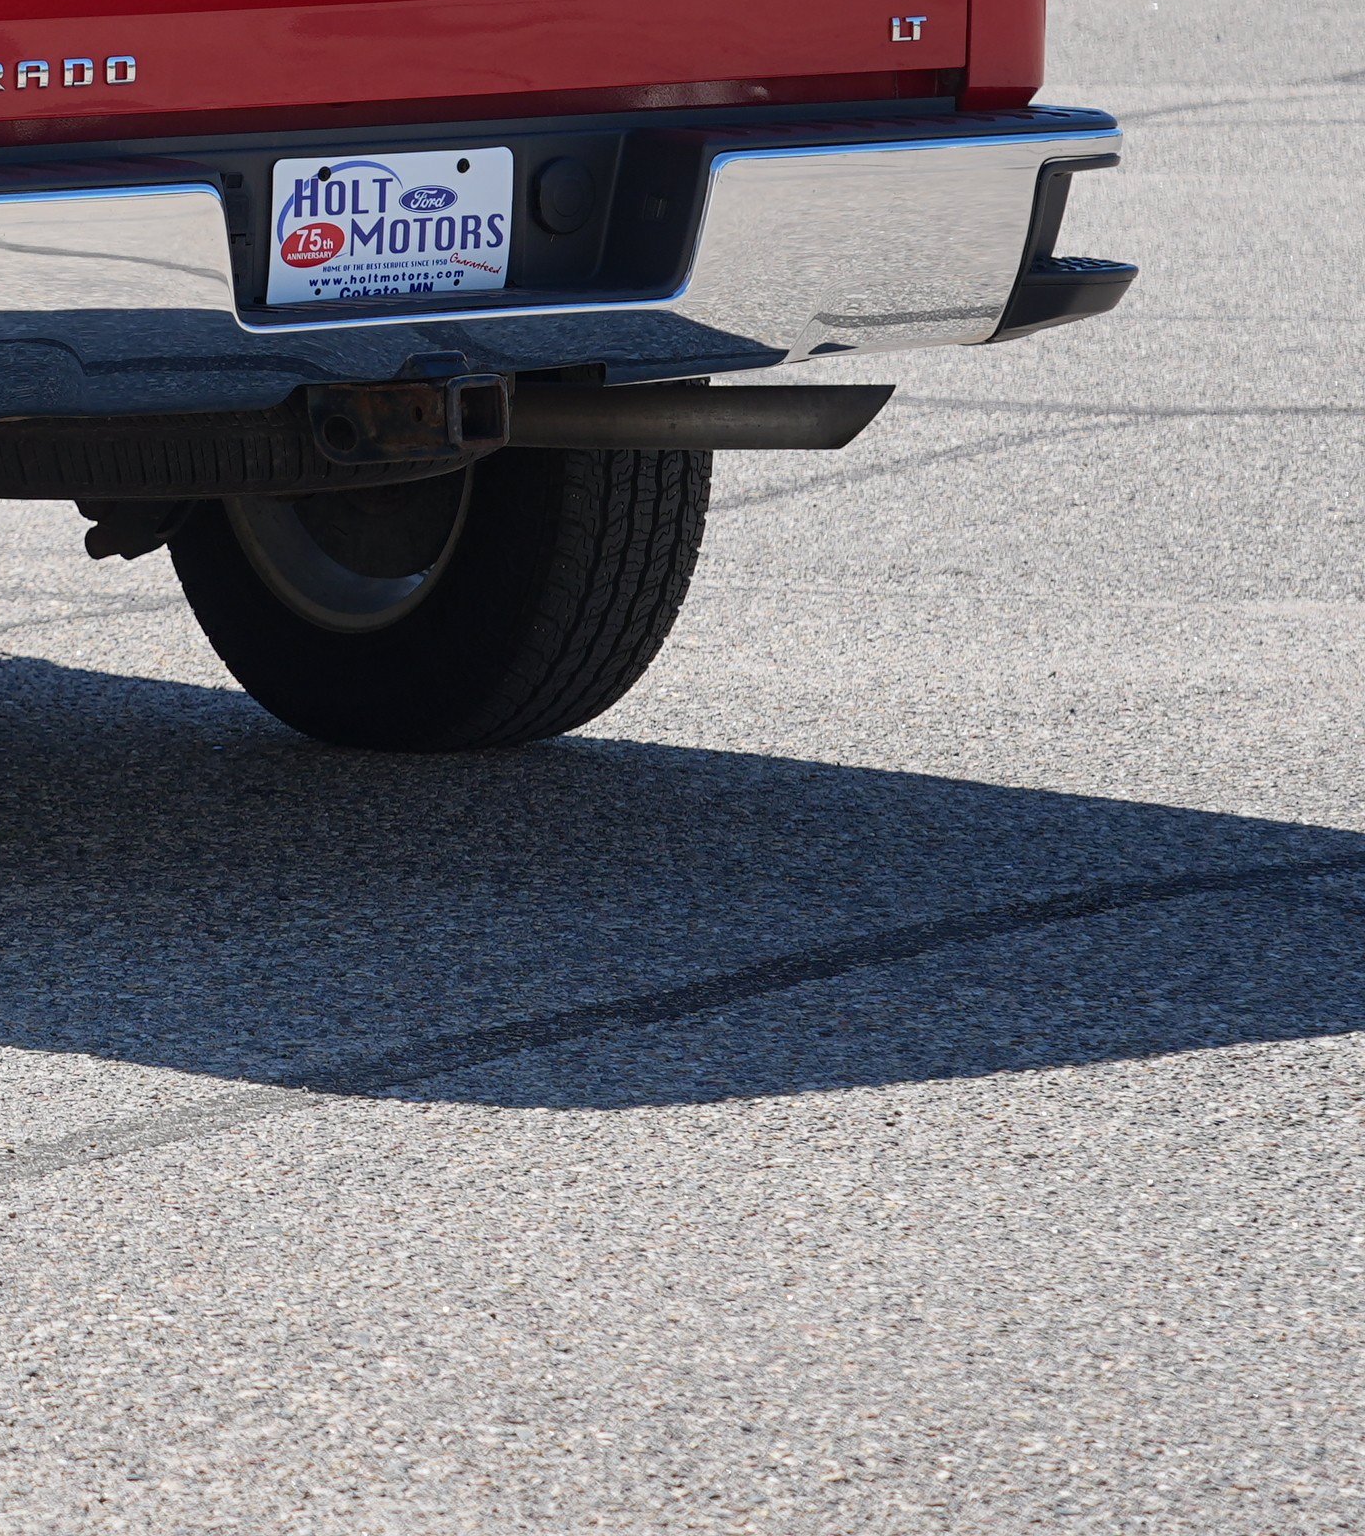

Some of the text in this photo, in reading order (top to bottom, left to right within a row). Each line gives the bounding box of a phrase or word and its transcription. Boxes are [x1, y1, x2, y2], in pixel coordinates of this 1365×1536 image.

[891, 16, 928, 42] LT
[293, 177, 394, 218] HOLT
[296, 228, 334, 252] 75th
[349, 213, 505, 257] MOTORS
[286, 250, 332, 261] ANNIVERSARY
[322, 265, 341, 273] HOME
[353, 263, 364, 271] THE
[366, 262, 381, 270] BEST
[411, 260, 429, 268] SINCE
[449, 252, 503, 275] Guaranteed
[309, 269, 465, 287] www.holtmotors.com
[409, 282, 434, 294] MN
